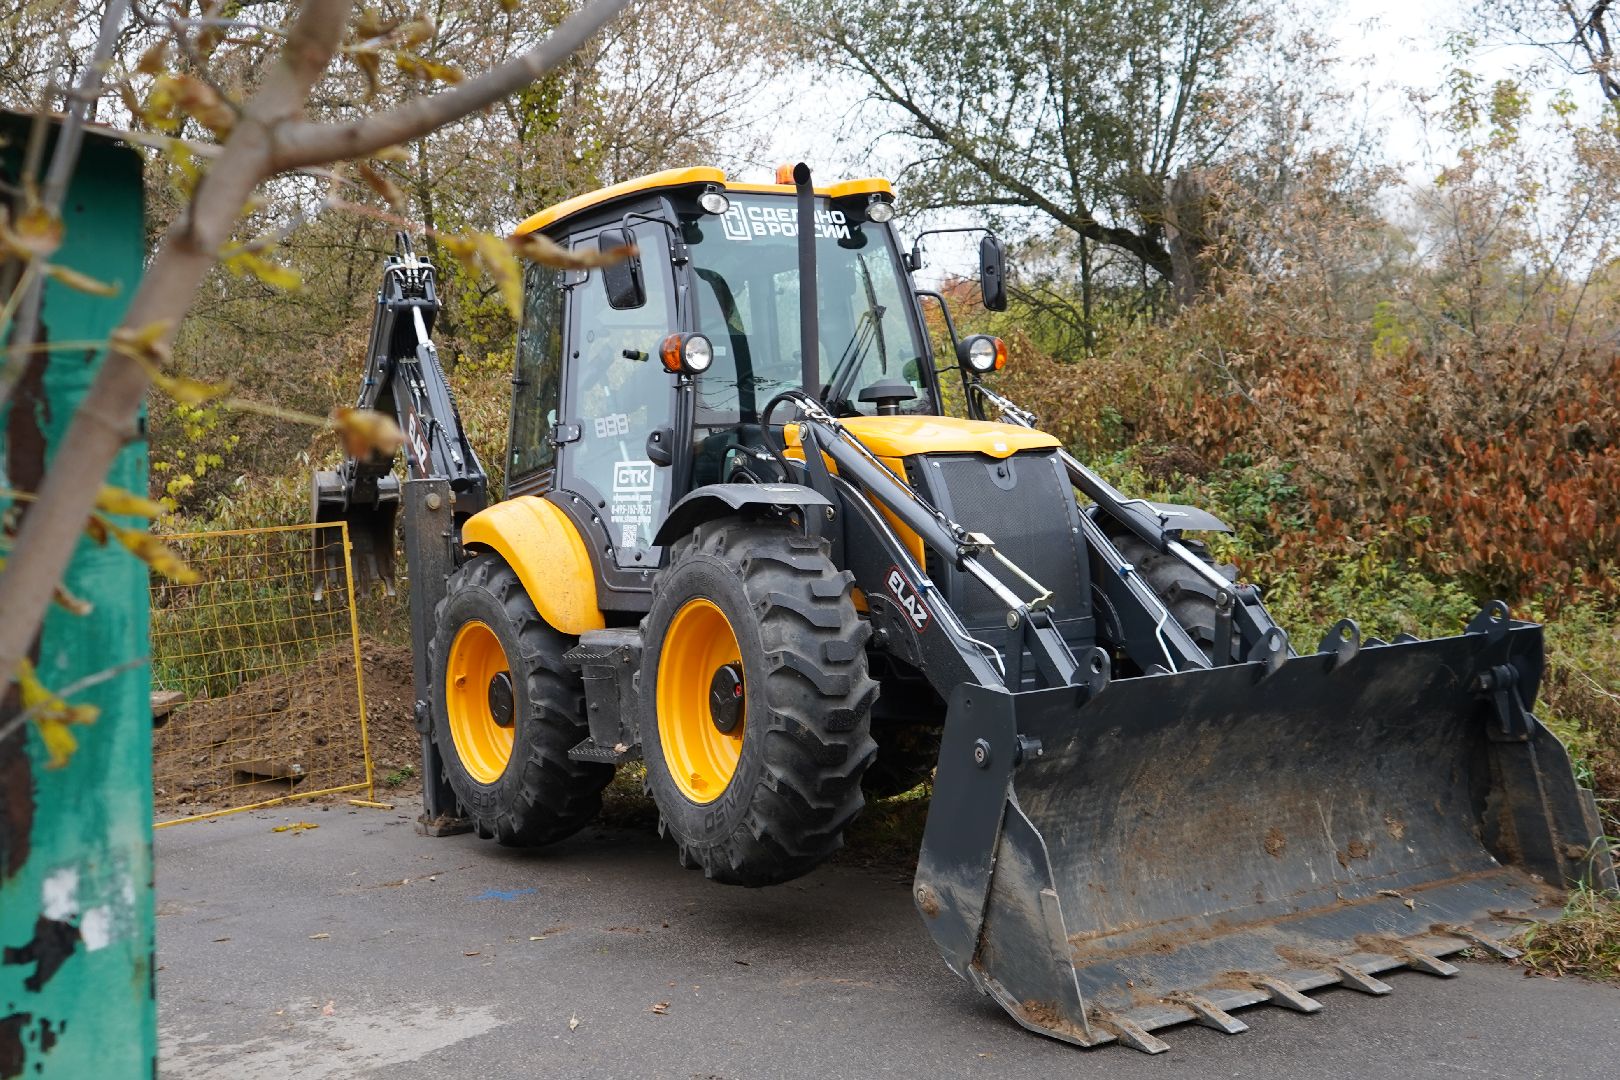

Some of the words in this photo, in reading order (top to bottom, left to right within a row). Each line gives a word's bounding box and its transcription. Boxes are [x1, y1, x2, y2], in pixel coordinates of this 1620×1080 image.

[751, 222, 767, 236] В
[766, 223, 851, 239] РОСИИ
[409, 413, 427, 473] ELAZ
[888, 570, 928, 628] ELAZ
